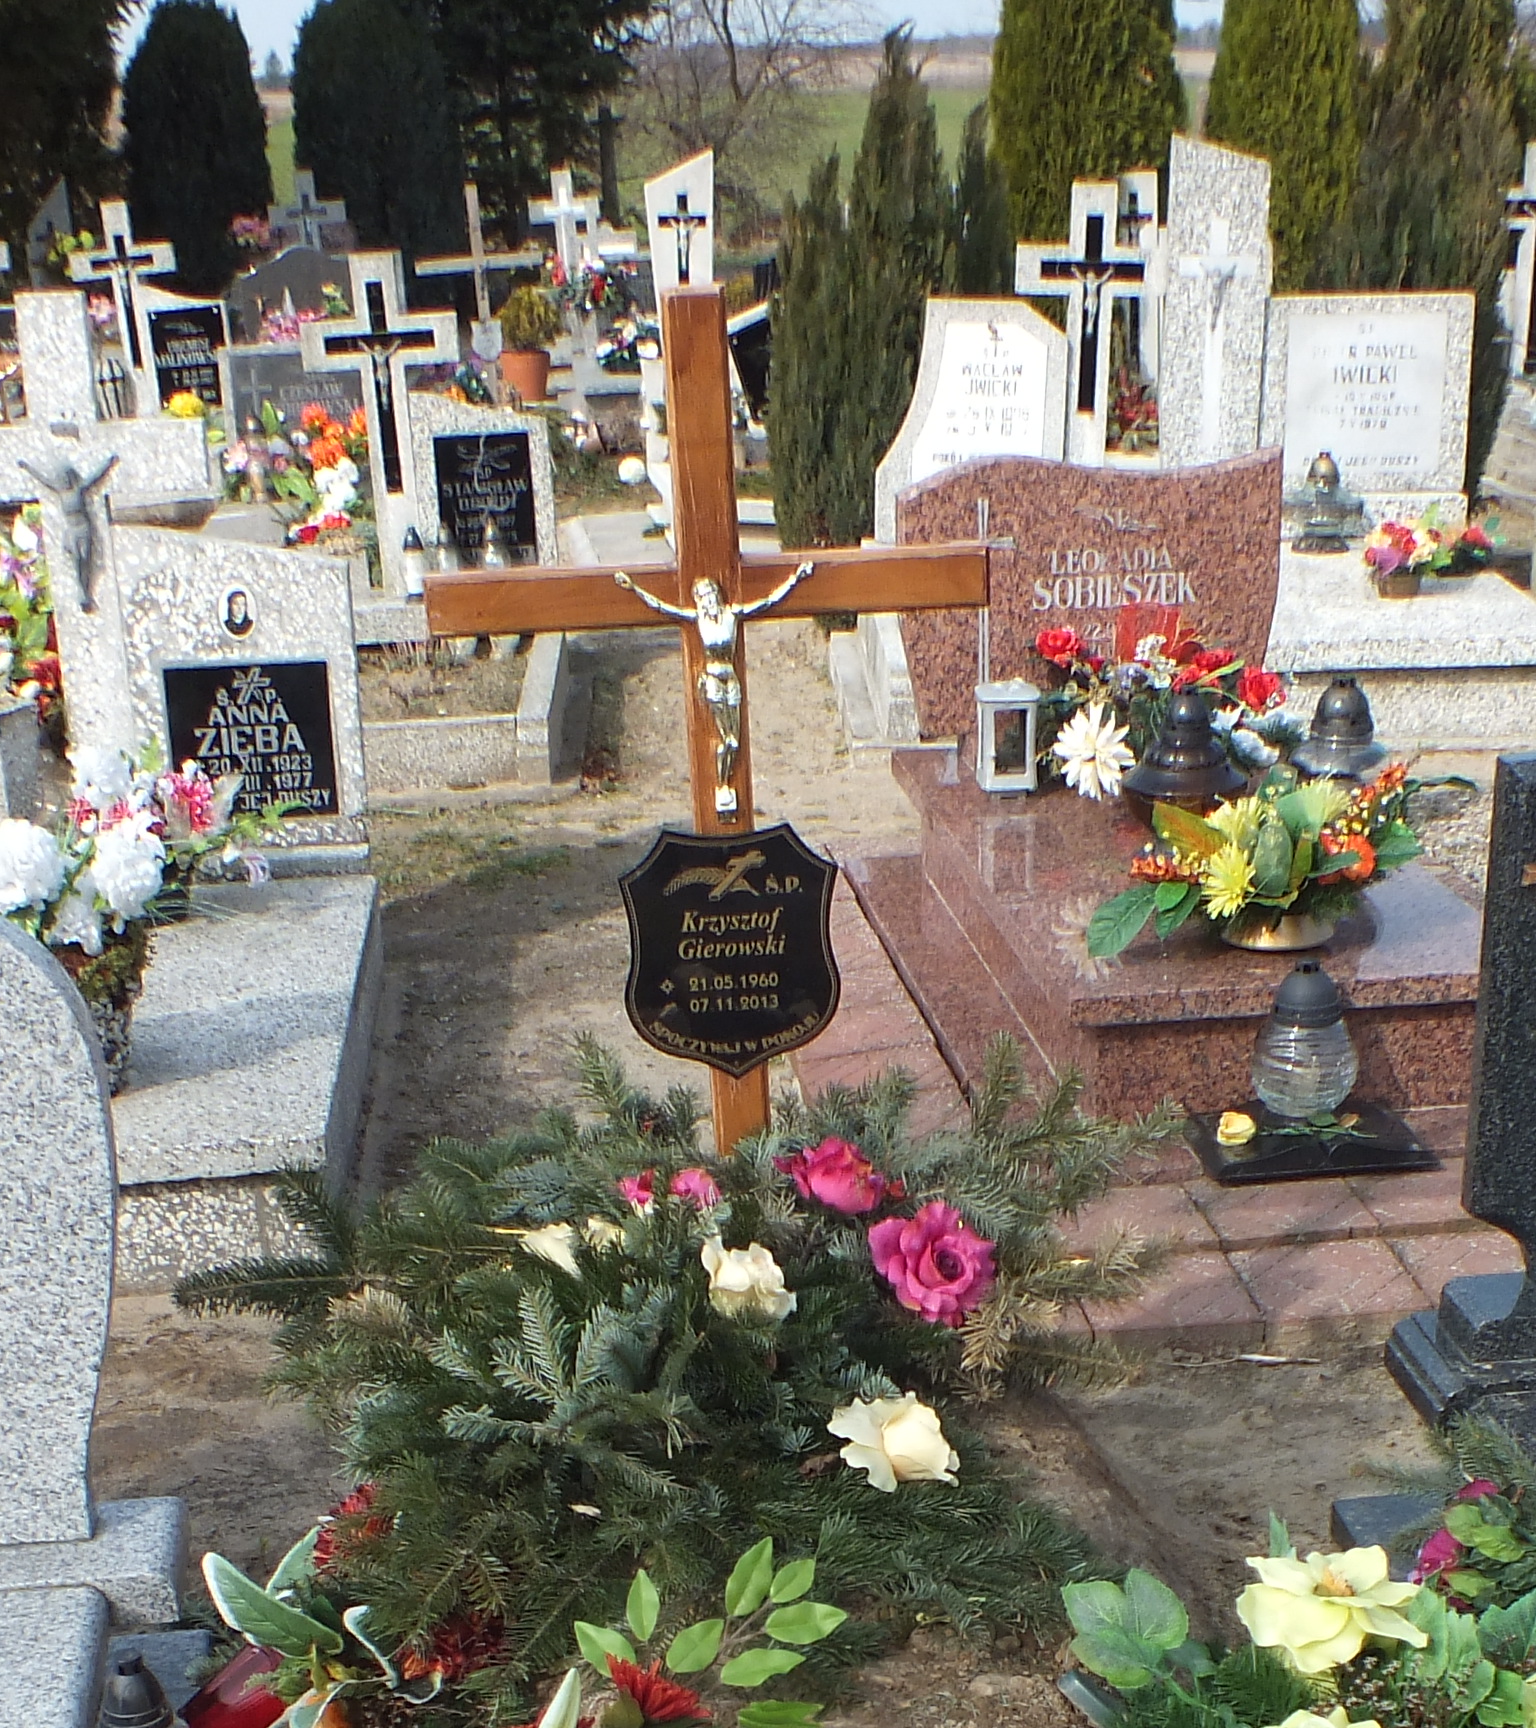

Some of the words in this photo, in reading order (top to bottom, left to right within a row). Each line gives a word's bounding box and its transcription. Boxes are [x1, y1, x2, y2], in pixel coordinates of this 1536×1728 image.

[1050, 545, 1174, 576] LEOADIA
[1032, 571, 1197, 611] SOBIESZEK
[207, 702, 281, 728] ANNA
[193, 721, 307, 764] ZIĘBA
[681, 906, 785, 936] Krzysztof
[677, 934, 788, 962] Gierowski
